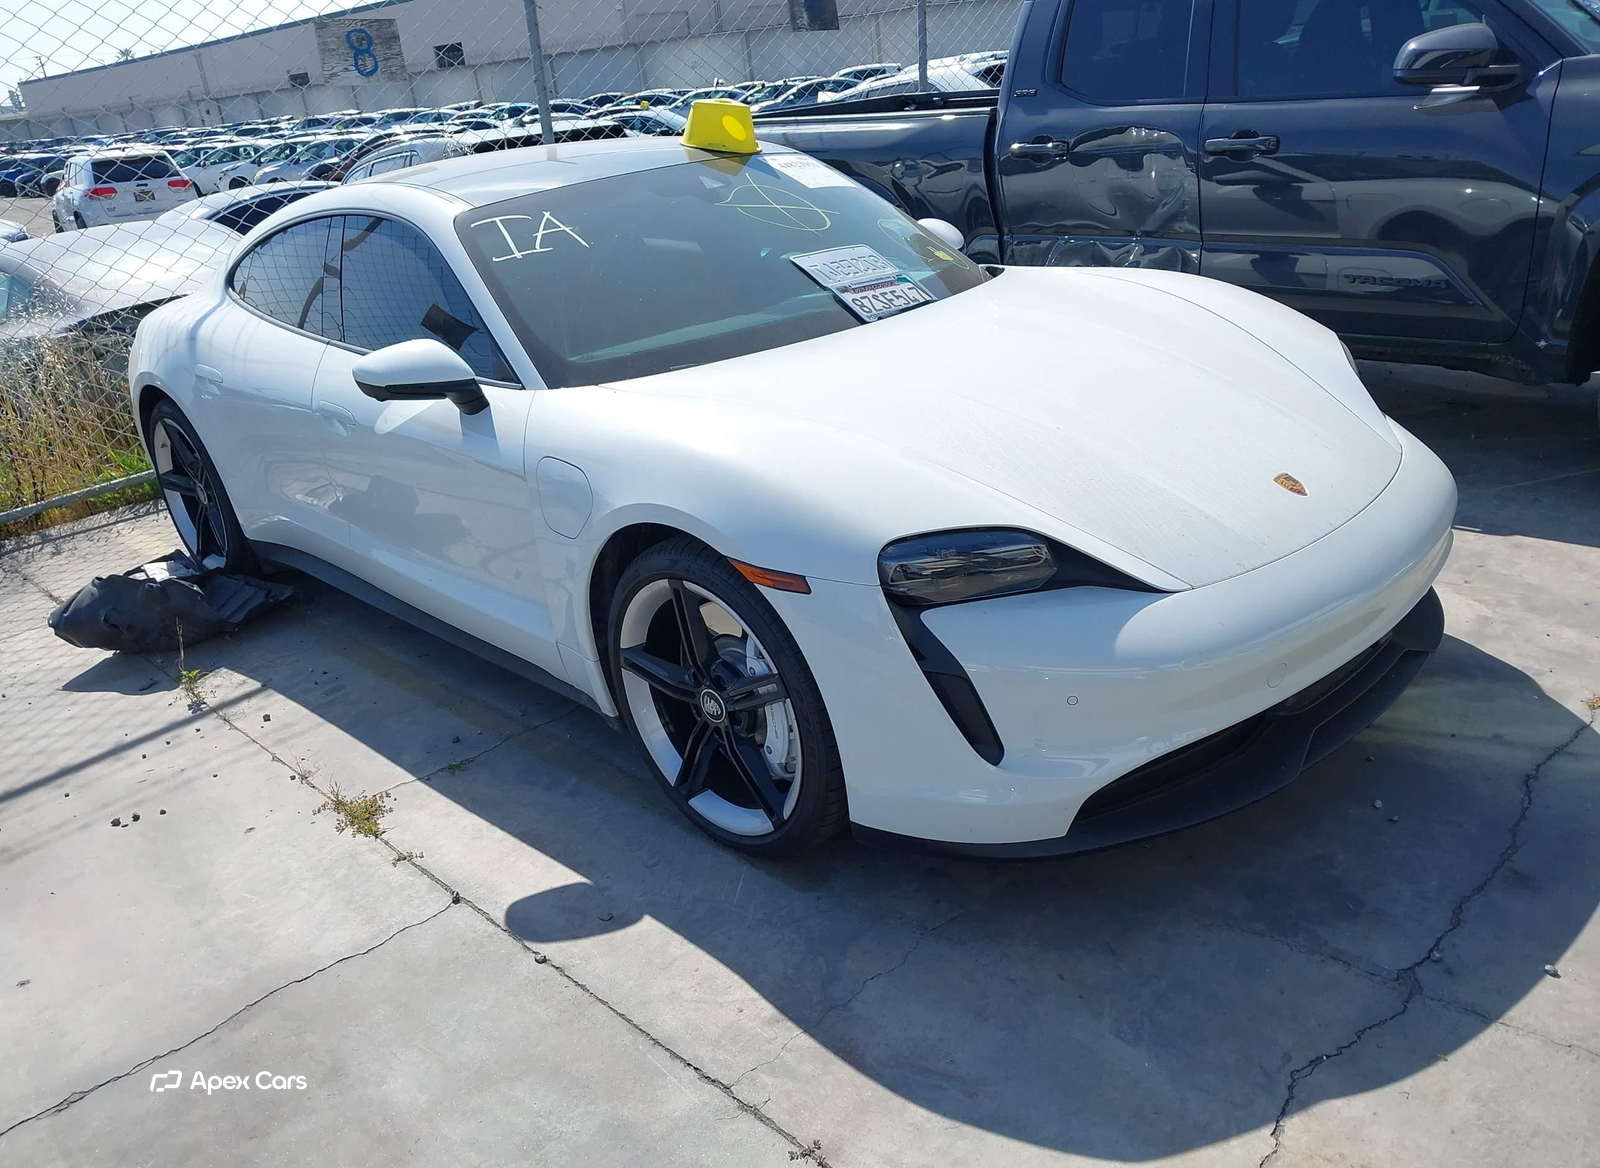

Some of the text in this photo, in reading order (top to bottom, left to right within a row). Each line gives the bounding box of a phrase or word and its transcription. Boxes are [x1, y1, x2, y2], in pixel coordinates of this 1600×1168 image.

[345, 27, 379, 78] 8
[1343, 273, 1447, 289] TACOMA
[851, 286, 925, 314] 8ZSE547
